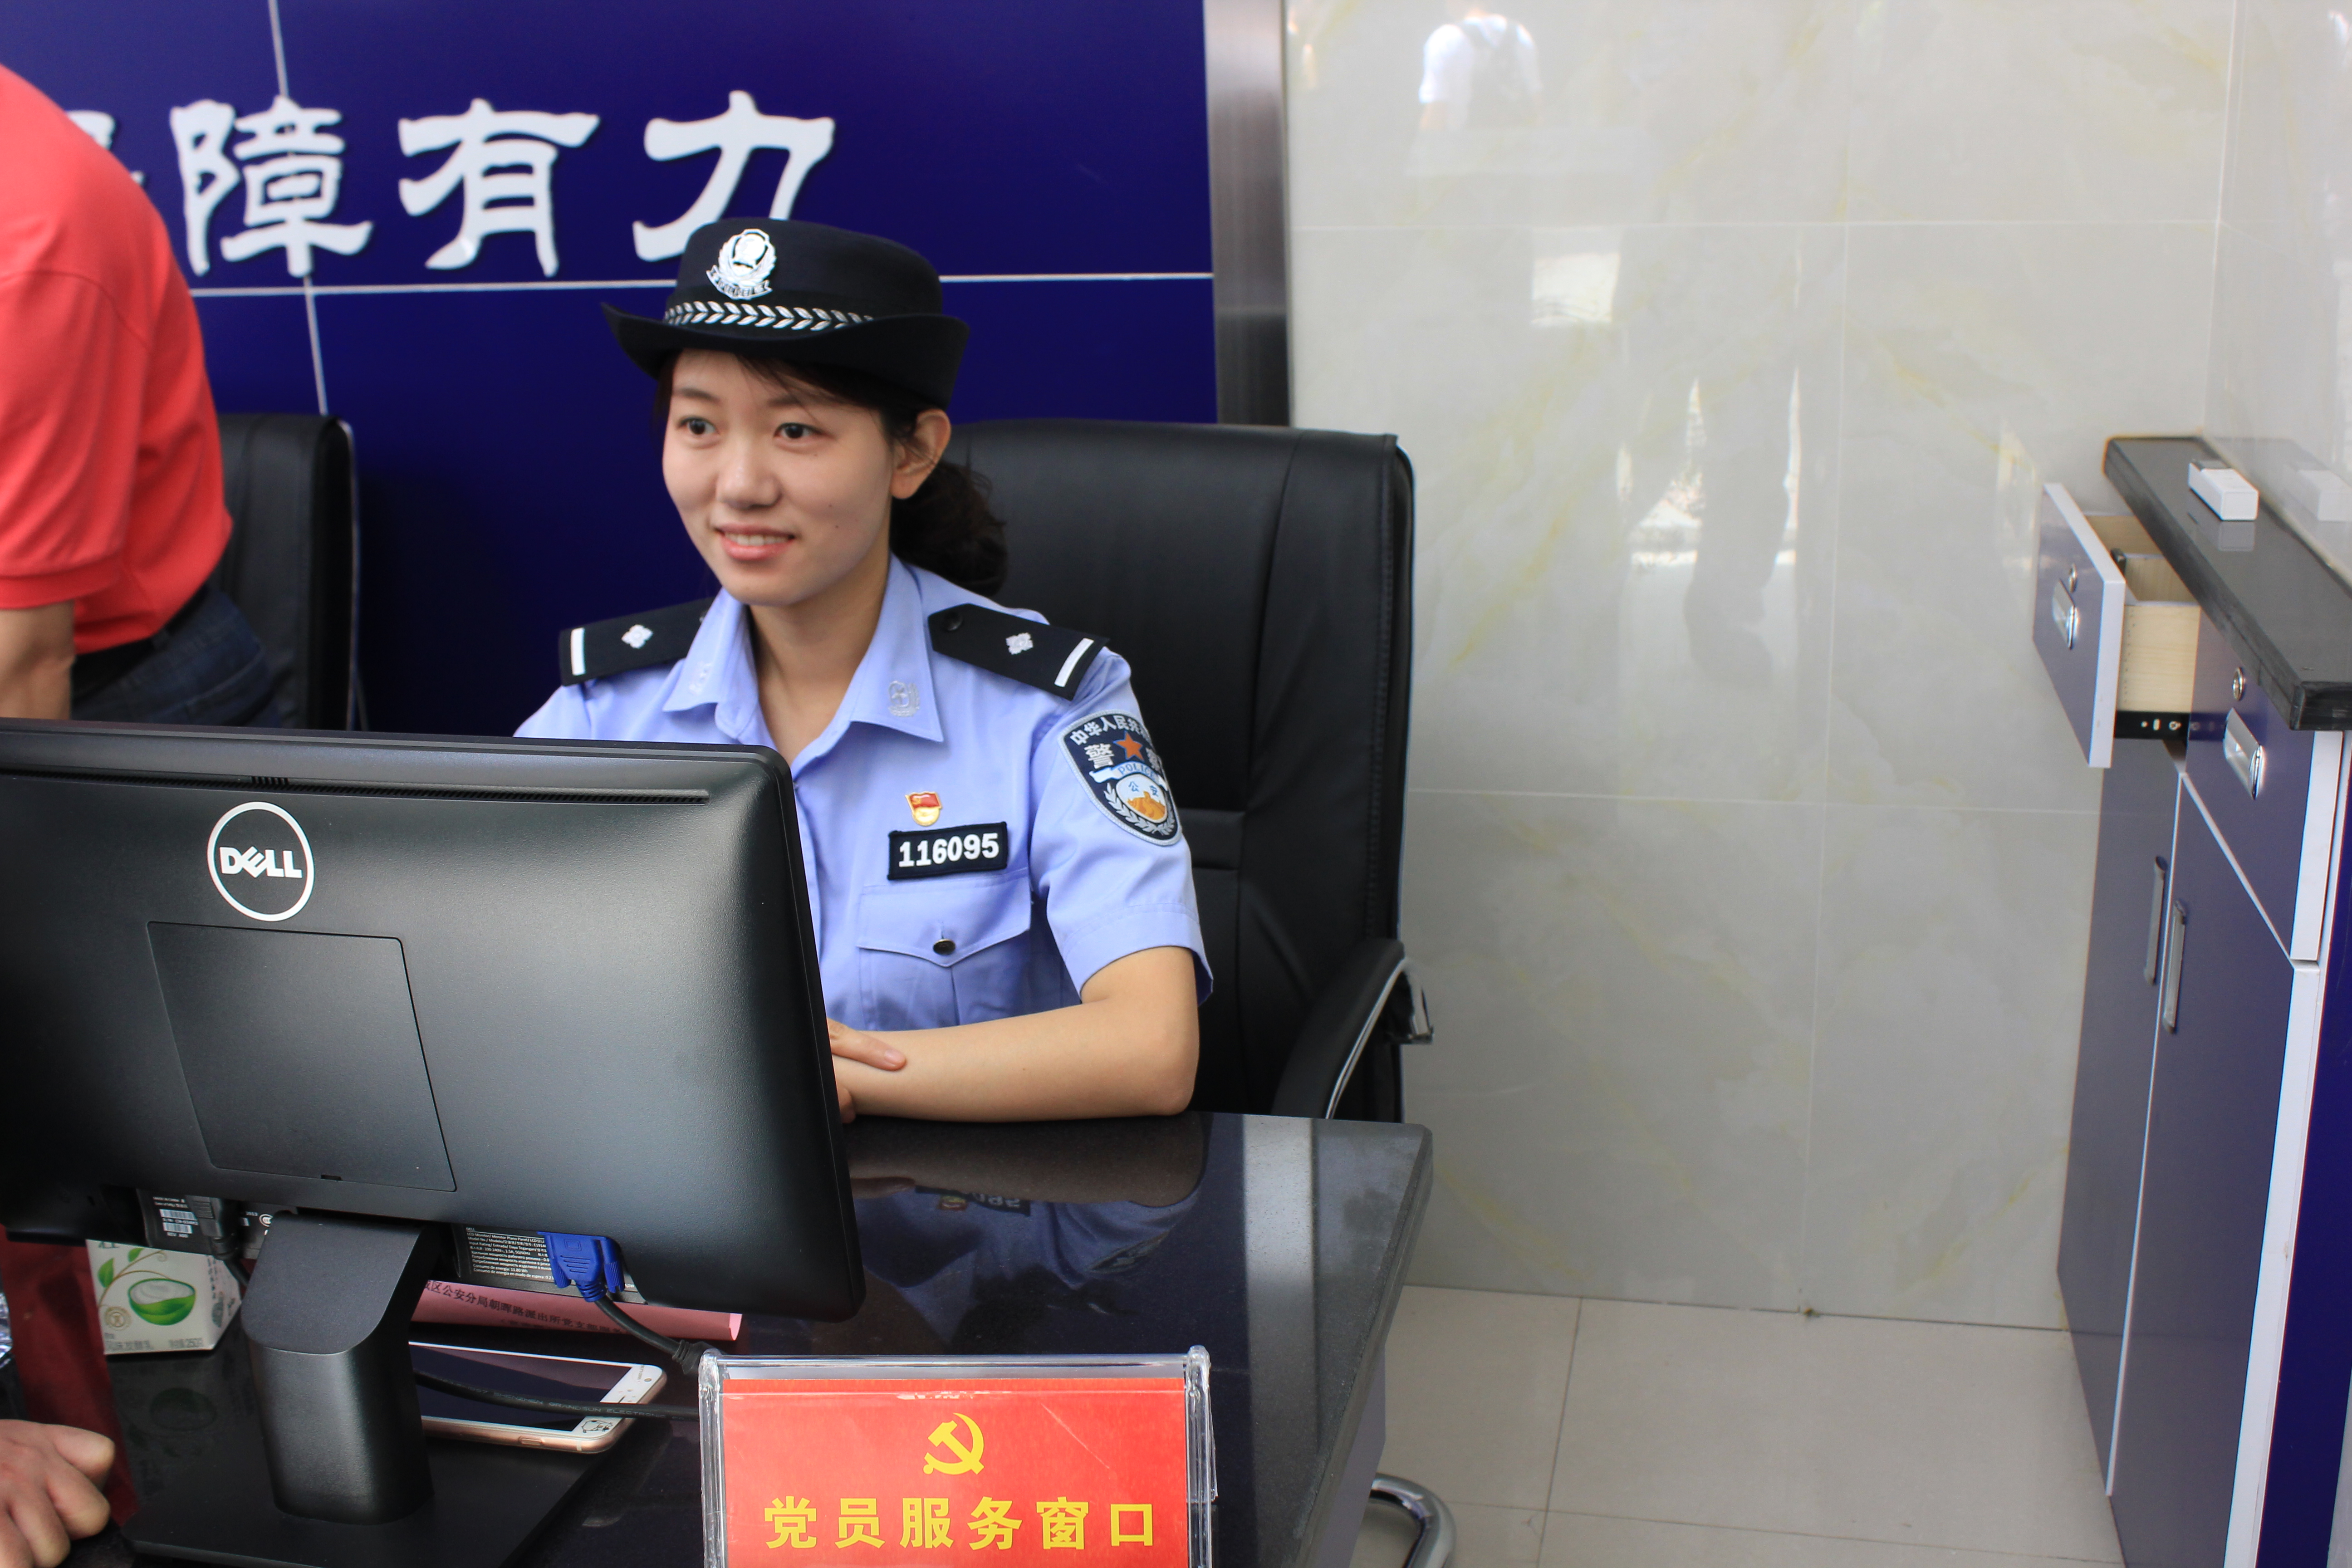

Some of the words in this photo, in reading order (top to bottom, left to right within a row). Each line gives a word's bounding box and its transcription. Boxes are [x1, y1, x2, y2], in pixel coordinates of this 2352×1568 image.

[68, 91, 836, 277] 障有力
[1117, 763, 1158, 781] POLICE
[219, 846, 303, 879] DELL
[898, 833, 999, 867] 116095
[549, 1401, 601, 1412] GRANDSUN
[607, 1409, 666, 1419] ELECTRONIC
[764, 1496, 1153, 1550] 党员服务窗口
